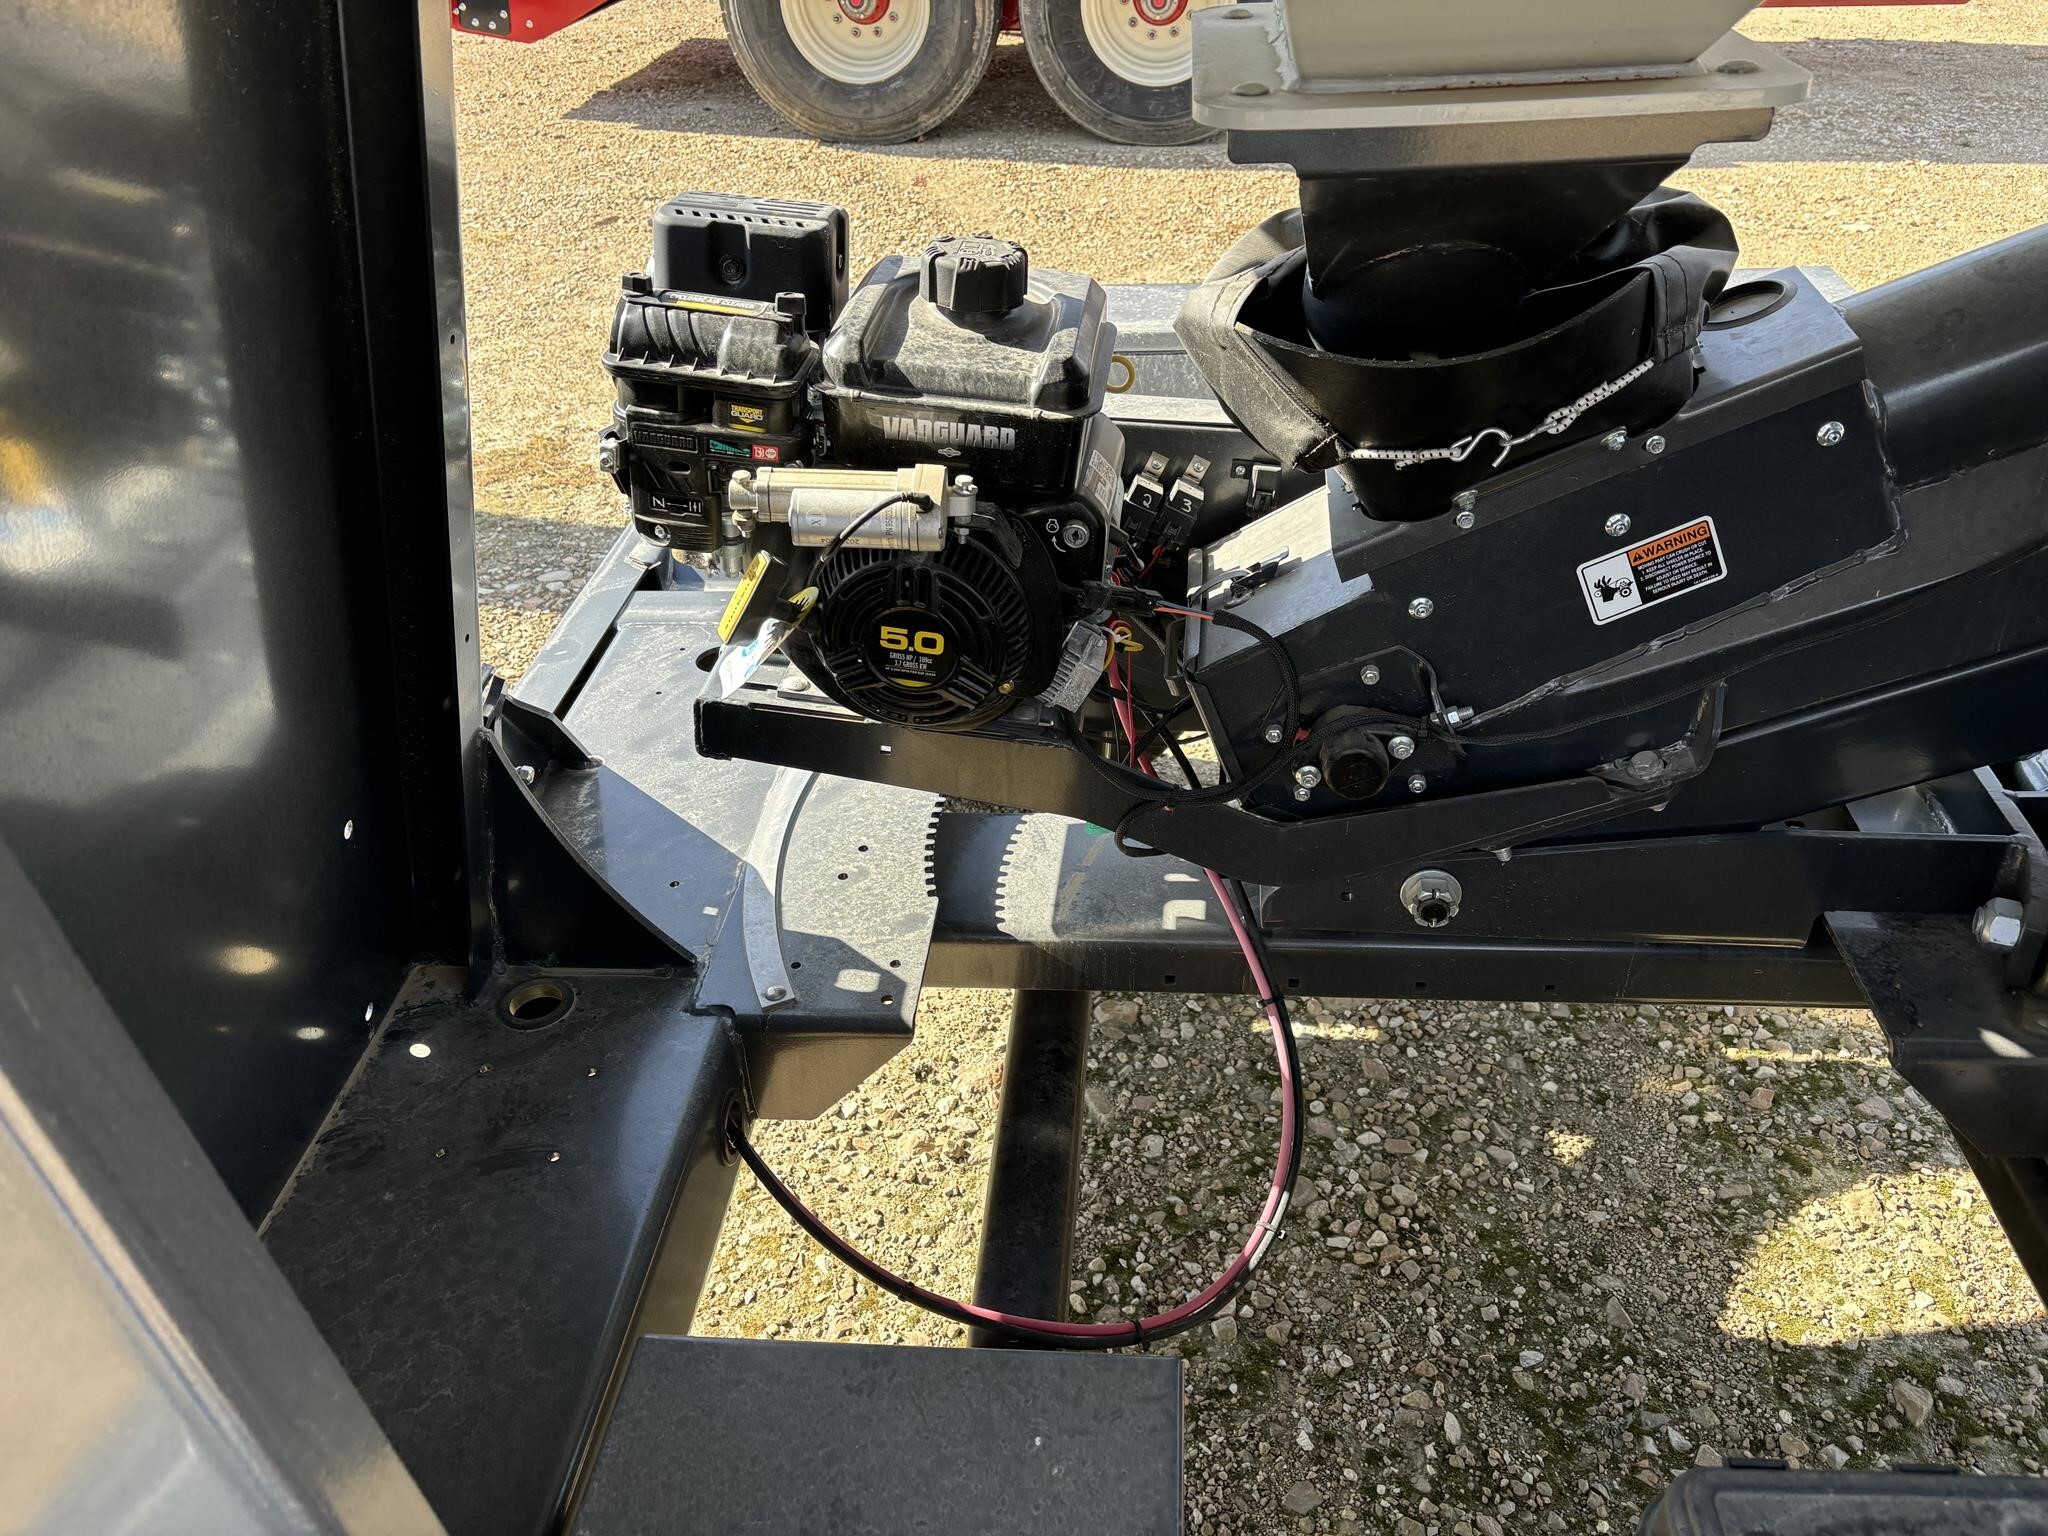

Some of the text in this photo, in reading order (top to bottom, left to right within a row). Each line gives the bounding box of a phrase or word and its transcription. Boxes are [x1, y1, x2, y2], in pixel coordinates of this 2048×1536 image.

[731, 405, 763, 415] TRANSPORT
[731, 410, 763, 420] GUARD
[634, 430, 694, 449] VANGUARD
[882, 416, 1015, 450] VANGUARD
[1143, 494, 1152, 508] 2
[1181, 499, 1192, 512] 3
[1642, 526, 1708, 557] WARNING
[1671, 560, 1687, 569] POWER
[1687, 553, 1705, 563] SOURCE
[1646, 565, 1658, 573] KEEP
[1645, 581, 1662, 591] FAILURE
[1669, 574, 1682, 582] HEED
[1690, 564, 1707, 574] RESULT
[1656, 572, 1672, 581] ADJUST
[880, 626, 944, 655] 5.0
[889, 652, 905, 660] GROSS
[902, 661, 919, 669] GROSS
